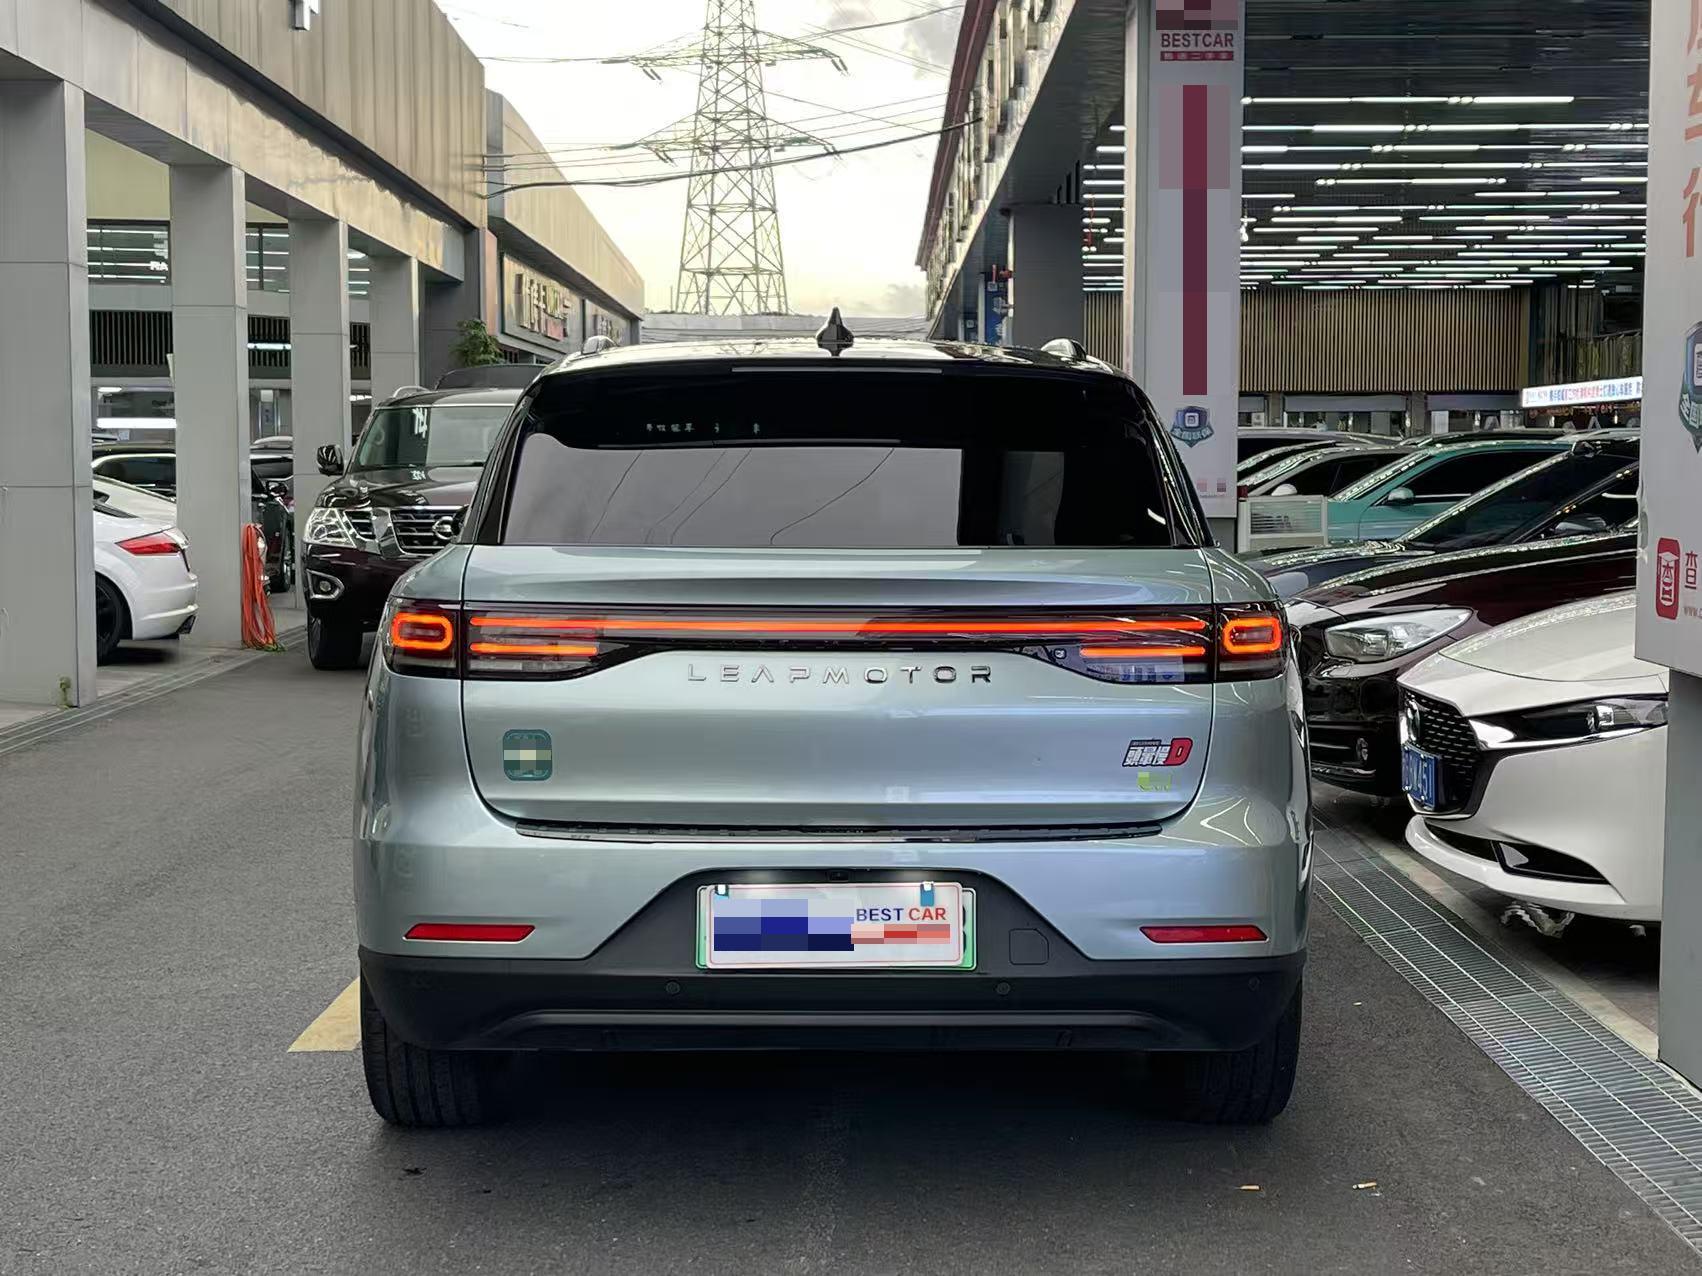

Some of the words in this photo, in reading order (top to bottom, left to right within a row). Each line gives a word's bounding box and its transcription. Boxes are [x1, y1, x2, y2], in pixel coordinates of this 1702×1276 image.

[1161, 33, 1234, 48] BESTCAR
[687, 663, 993, 685] LEAPMOTOR
[856, 907, 904, 922] BEST
[908, 907, 947, 921] CAR
